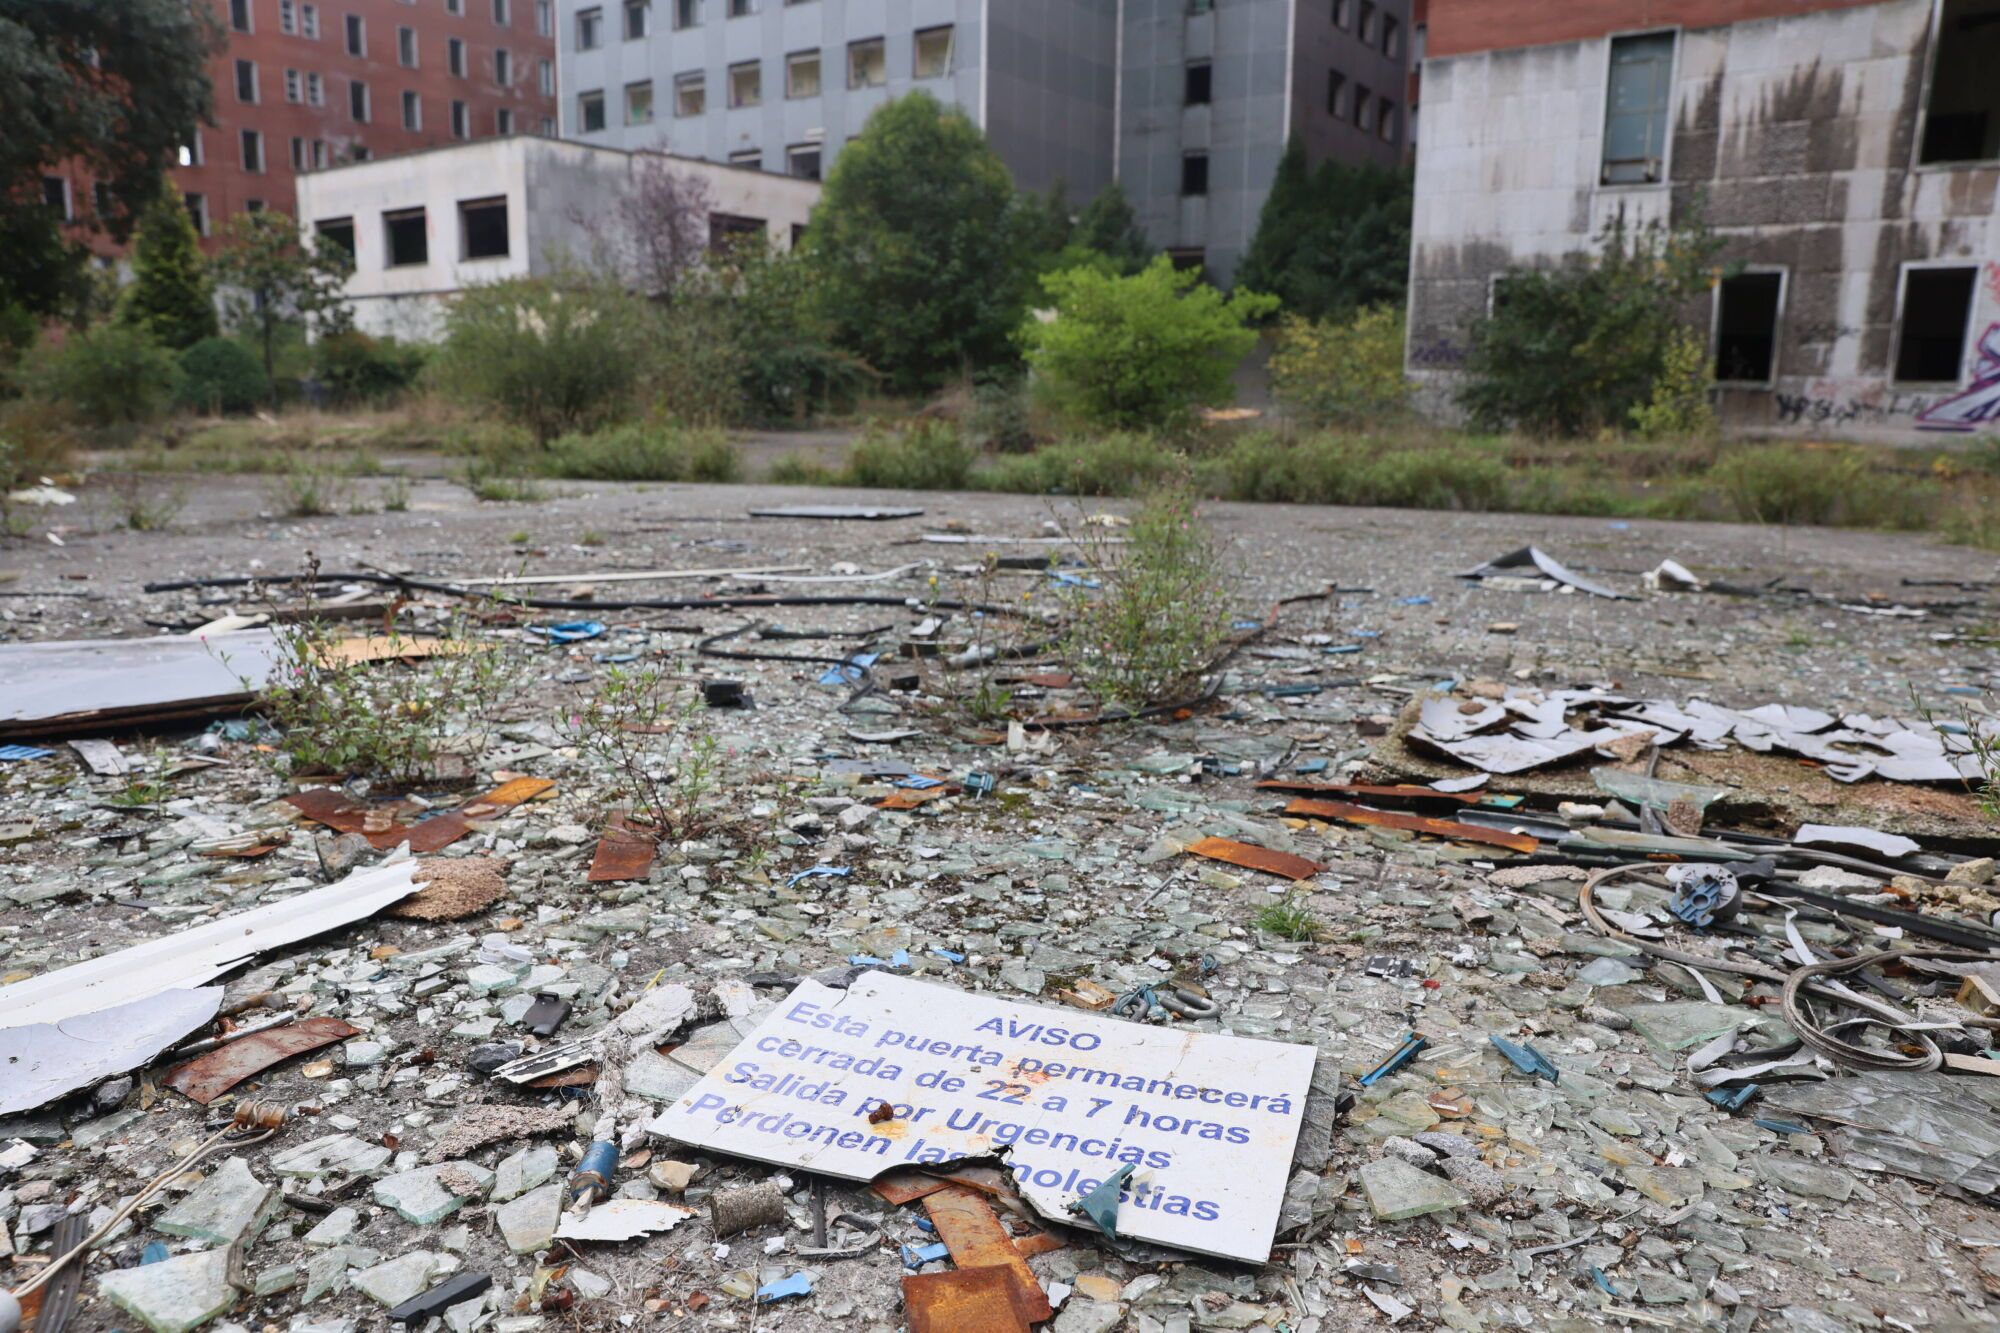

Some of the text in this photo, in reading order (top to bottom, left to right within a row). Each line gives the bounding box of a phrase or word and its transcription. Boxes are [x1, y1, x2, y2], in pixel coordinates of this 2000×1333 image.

[785, 1001, 1293, 1115] Esta puerta permanecerá
[974, 1017, 1102, 1051] AVISO
[723, 1061, 1173, 1169] Salida por Urgencias
[756, 1035, 1251, 1145] cerrada de 22 a 7 horas
[686, 1092, 893, 1155] Perdonen
[1006, 1160, 1221, 1222] oletias
